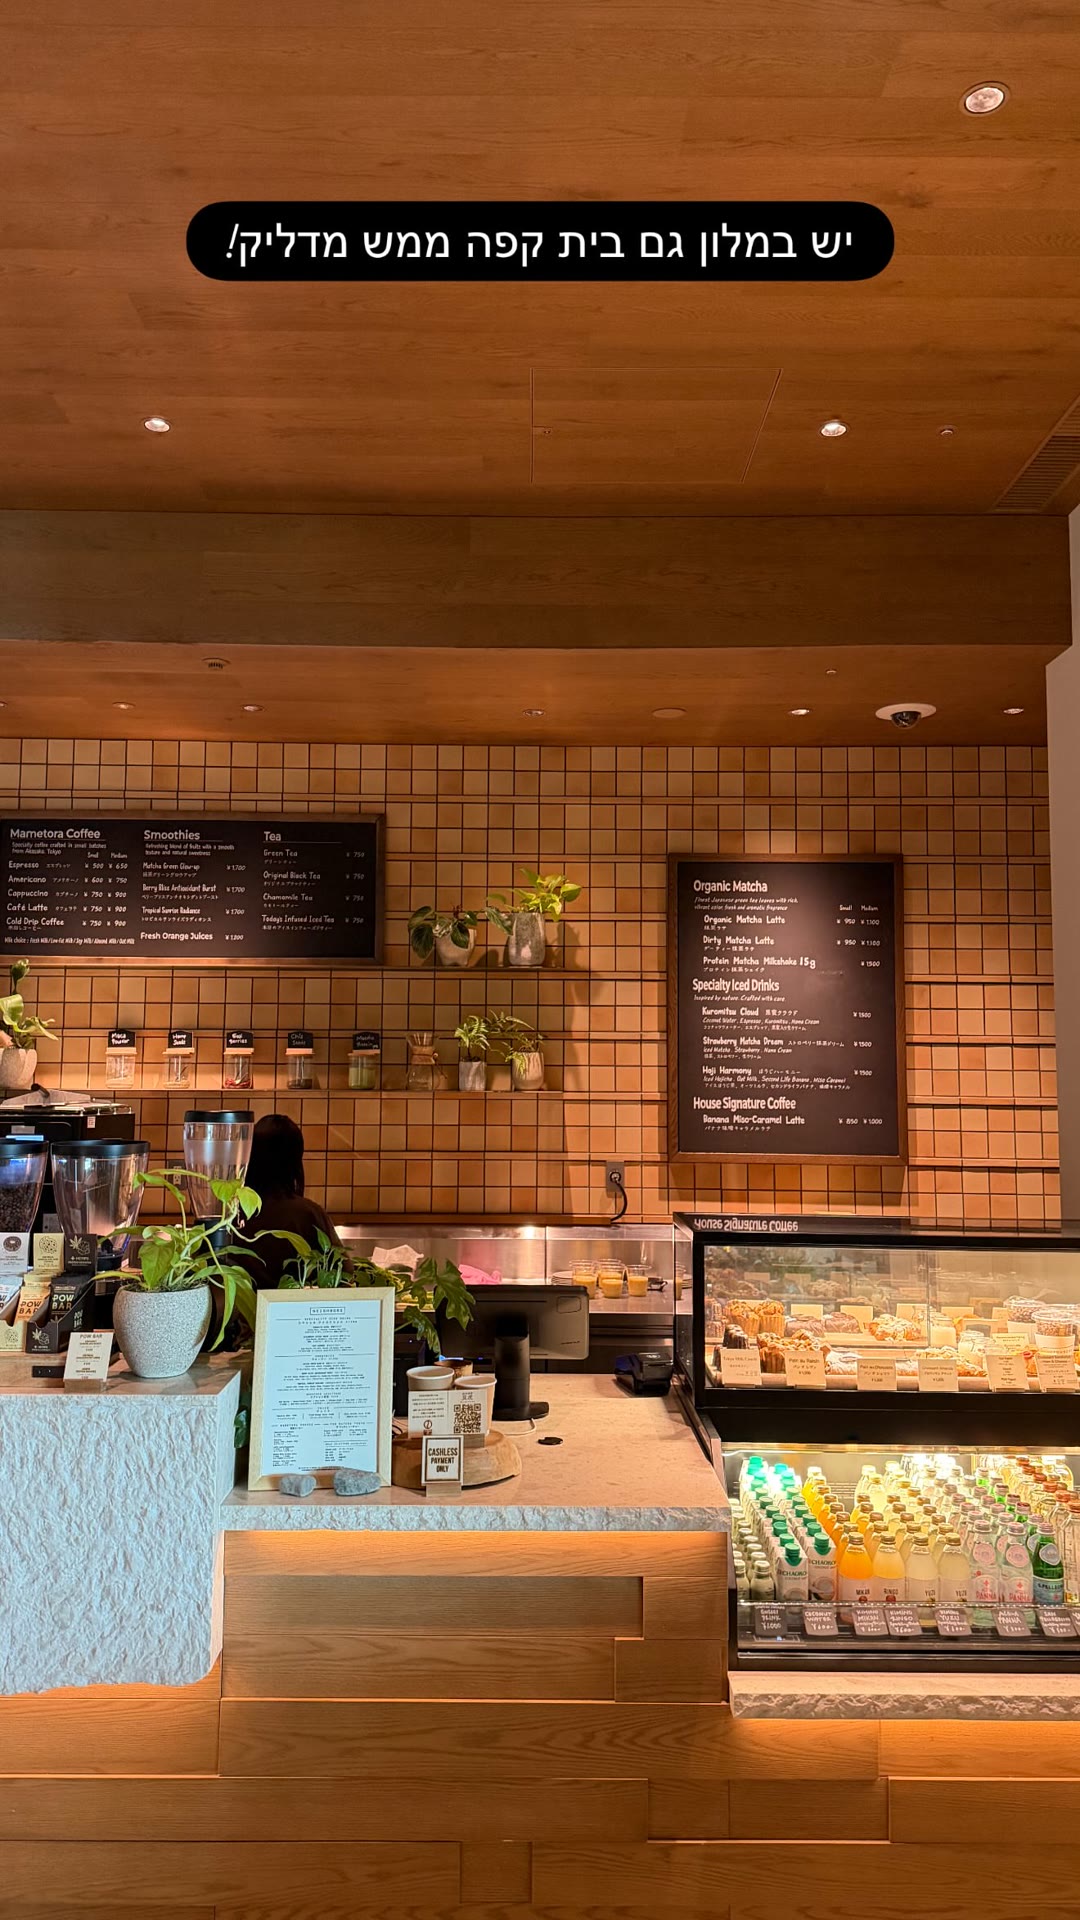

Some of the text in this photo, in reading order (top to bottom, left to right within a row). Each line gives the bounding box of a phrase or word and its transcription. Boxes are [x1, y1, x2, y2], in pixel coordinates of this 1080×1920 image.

[10, 828, 100, 838] Mametora Coffee
[144, 830, 200, 840] Smoothies
[264, 832, 282, 841] Tea
[47, 848, 62, 856] Tokyo
[263, 848, 298, 857] Green Tea
[8, 860, 40, 870] Espresso
[142, 862, 162, 870] Matcha
[162, 862, 178, 870] Green
[263, 870, 320, 880] Original Black Tea
[142, 884, 217, 892] Berry Bliss Antioxidant Burst
[694, 880, 768, 894] Organic Matcha
[8, 888, 48, 898] Cappuccino
[262, 892, 298, 900] Chamomile
[142, 906, 161, 914] Tropical
[161, 906, 178, 914] Sunrise
[6, 917, 64, 926] Cold Drip Coffee
[704, 914, 786, 925] Organic Matcha Latte
[140, 932, 214, 941] Fresh Orange Juices
[703, 936, 774, 946] Dirty Matcha Latte
[703, 956, 816, 970] Protein Matcha Milkshake 15g
[692, 978, 780, 994] Specialty Iced Drinks
[740, 994, 760, 1002] Crafted
[702, 1006, 759, 1016] Kuromitsu Cloud
[702, 1036, 784, 1047] Strawberry Matcha Dream
[702, 1066, 752, 1076] Hoji Harmony
[693, 1096, 796, 1112] House Signature Coffee
[702, 1114, 806, 1125] Banana Miso-Caramel Latte
[52, 1294, 74, 1302] POW
[428, 1447, 458, 1456] CASHLESS
[430, 1456, 455, 1464] PAYMENT
[436, 1464, 449, 1473] ONLY
